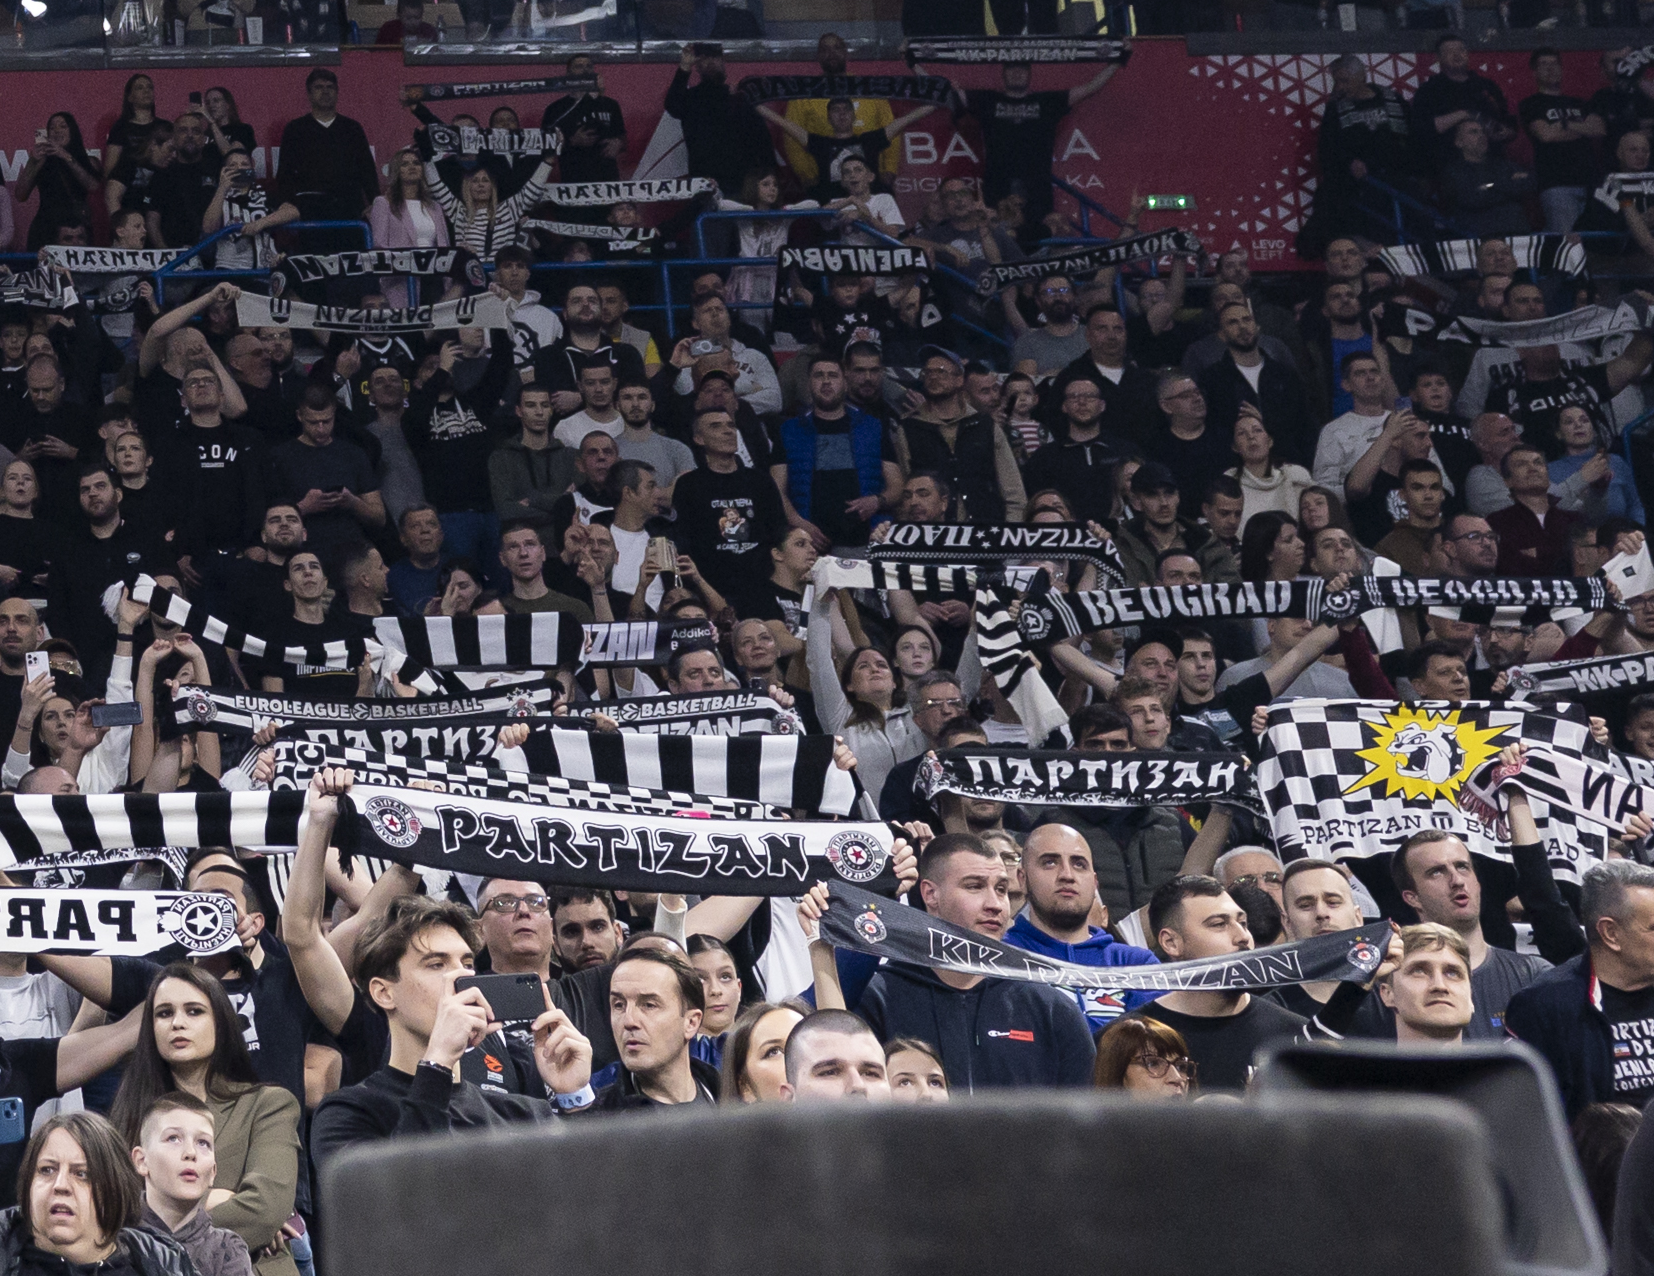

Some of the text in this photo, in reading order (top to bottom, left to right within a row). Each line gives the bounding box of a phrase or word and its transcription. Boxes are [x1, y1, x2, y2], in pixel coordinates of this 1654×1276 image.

[1252, 239, 1286, 250] LEVO
[1253, 250, 1284, 262] LEFT
[1088, 579, 1295, 626] BEOGRAD
[234, 694, 483, 721] EUROLEAGUE BASKETBALL
[642, 694, 757, 719] BASKETBALL
[964, 750, 1240, 792] ПАРТИЗАН
[435, 805, 810, 878] PARTIZAN
[1301, 814, 1424, 852] PARTIZAN
[927, 926, 1306, 991] KK PARTIZAN
